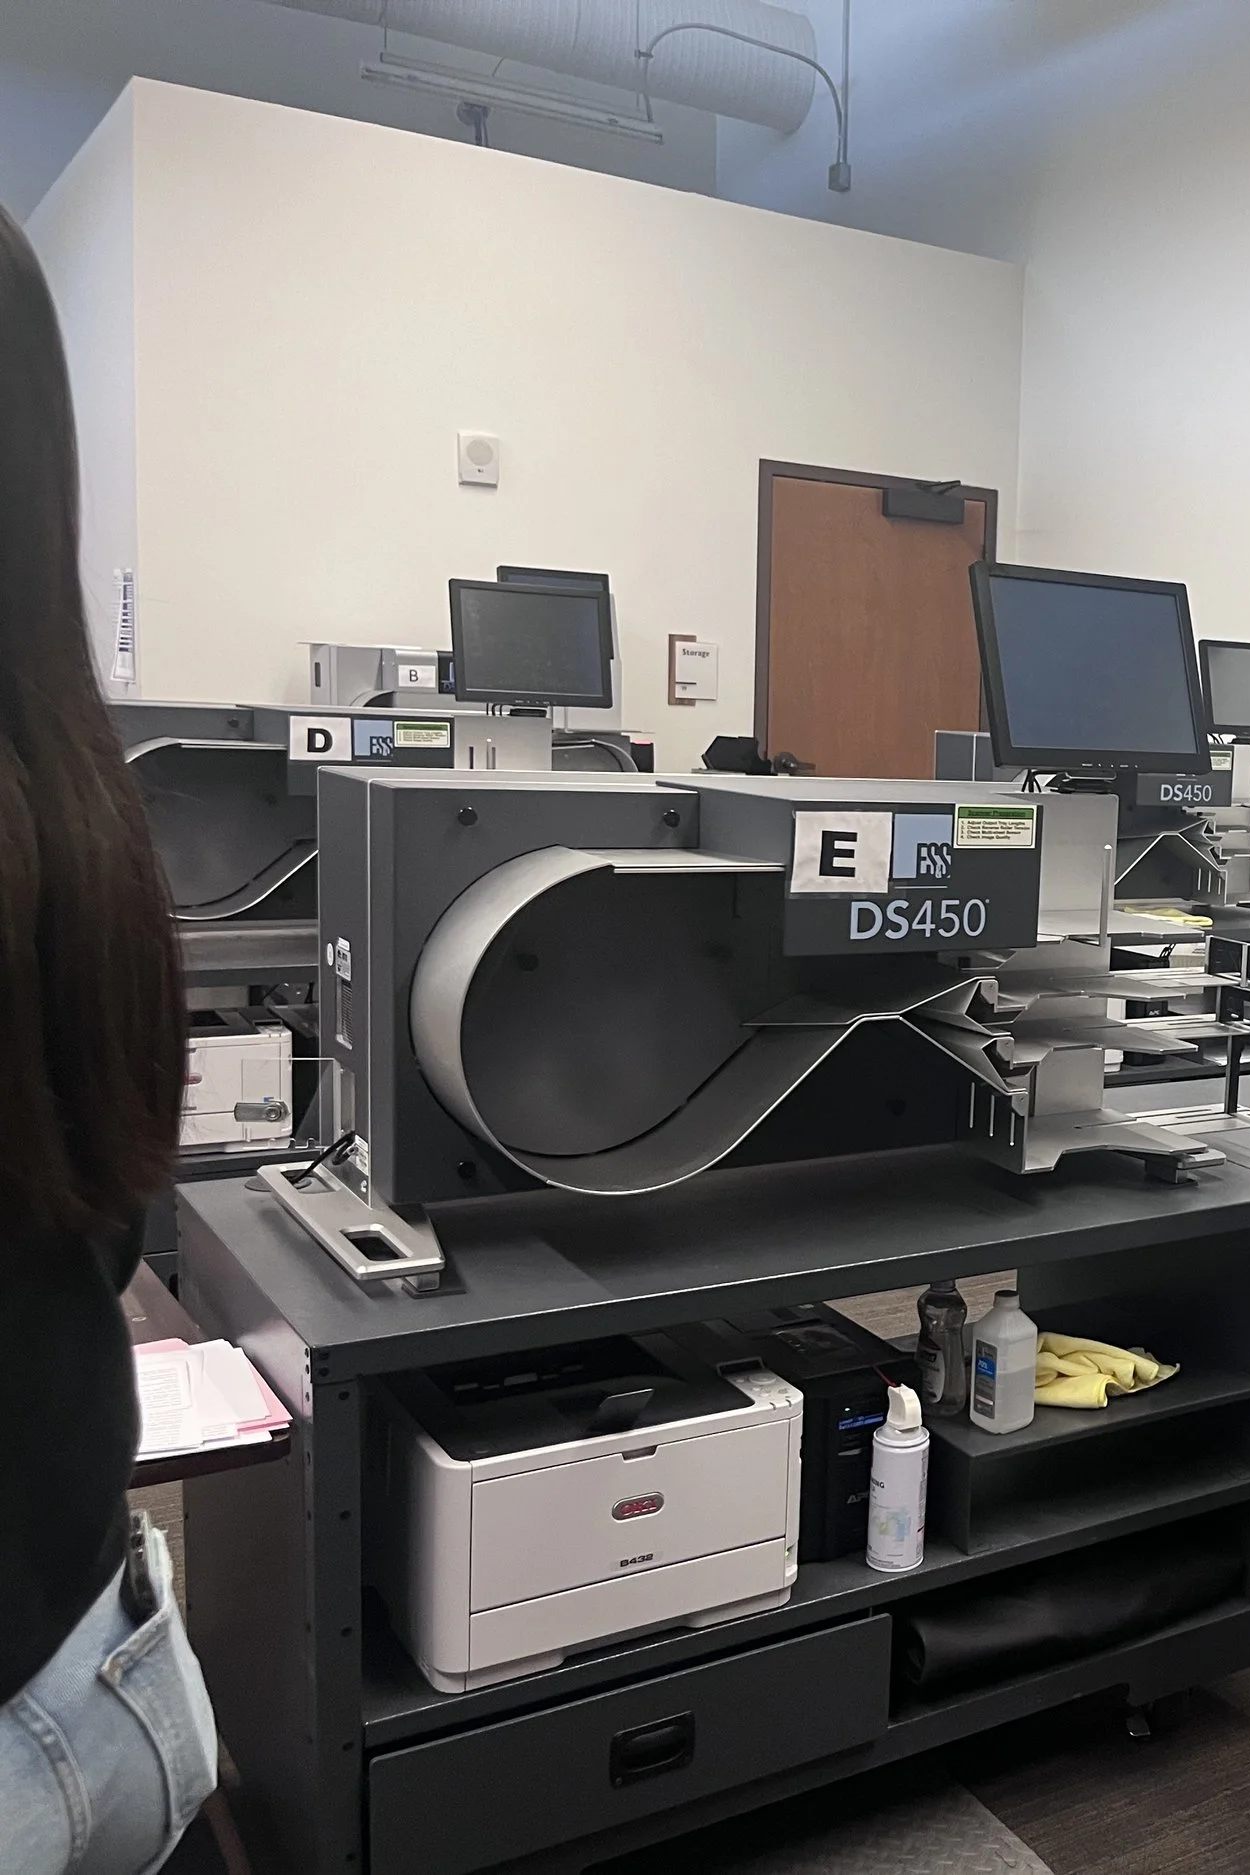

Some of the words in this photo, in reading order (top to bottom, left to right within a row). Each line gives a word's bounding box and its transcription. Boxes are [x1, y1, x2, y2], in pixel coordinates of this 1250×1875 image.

[682, 648, 710, 658] Storage
[409, 669, 419, 682] B
[307, 728, 333, 753] D
[1160, 784, 1212, 802] DS450
[819, 830, 858, 878] E
[850, 899, 987, 940] DS450
[620, 1553, 654, 1567] B432
